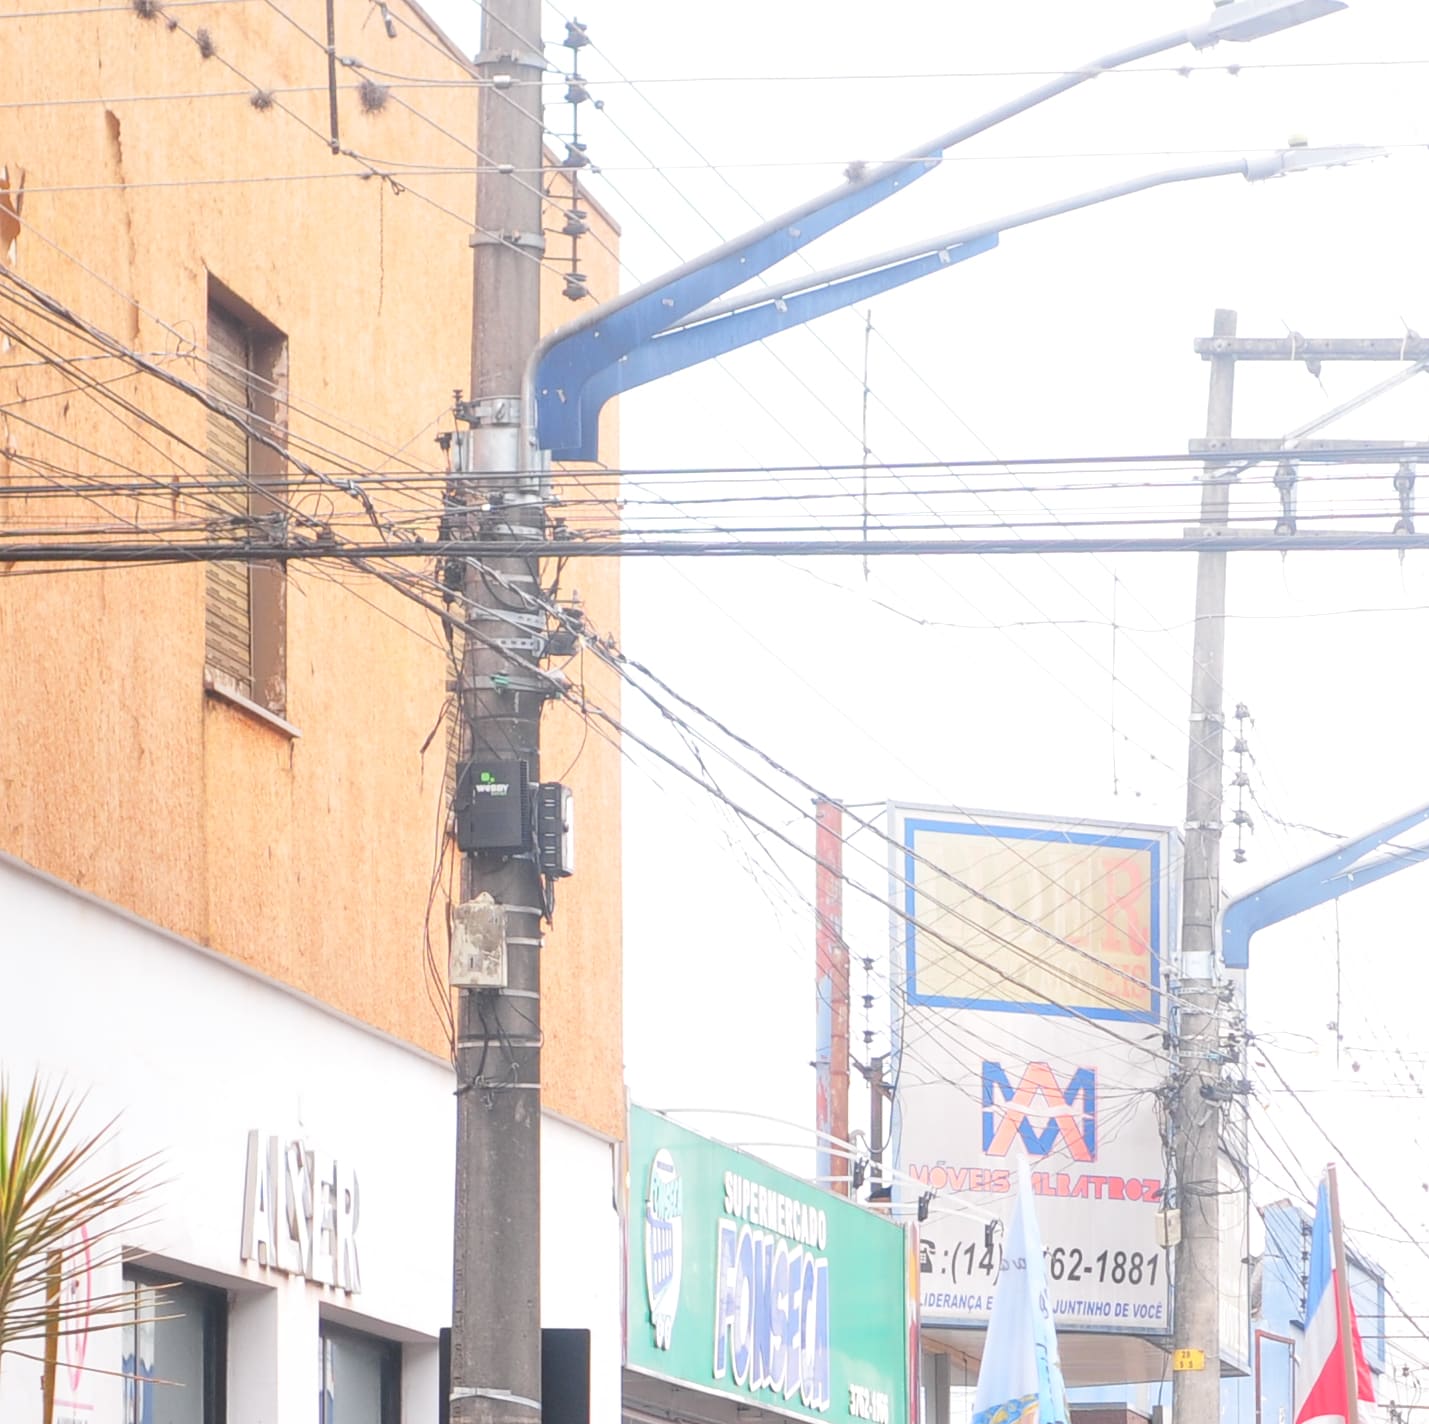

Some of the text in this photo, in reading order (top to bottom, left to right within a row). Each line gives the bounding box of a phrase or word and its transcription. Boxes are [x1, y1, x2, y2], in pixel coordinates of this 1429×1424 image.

[908, 1160, 1012, 1194] MÓVEIS
[724, 1170, 827, 1251] SUPERMERCADO
[1049, 1246, 1160, 1287] 62-1881
[713, 1216, 831, 1413] FONSECA
[1052, 1299, 1111, 1317] JUNTINHO
[1114, 1302, 1130, 1318] DE
[1132, 1300, 1163, 1319] VOCÊ
